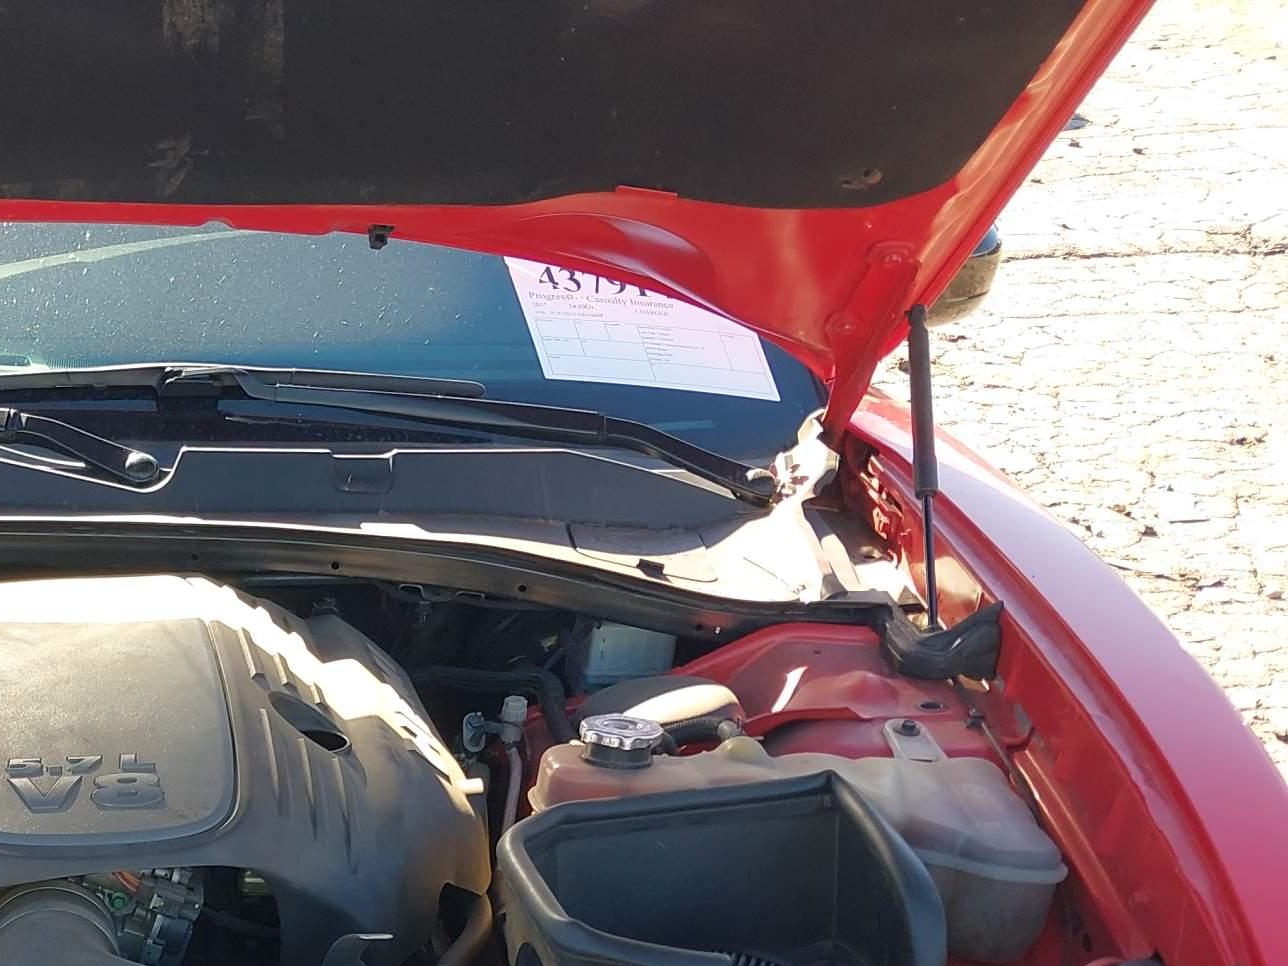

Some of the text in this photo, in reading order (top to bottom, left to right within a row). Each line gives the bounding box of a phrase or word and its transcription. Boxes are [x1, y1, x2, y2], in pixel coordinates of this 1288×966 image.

[528, 291, 674, 309] Progressi Casualty Insurance
[6, 772, 165, 811] V8
